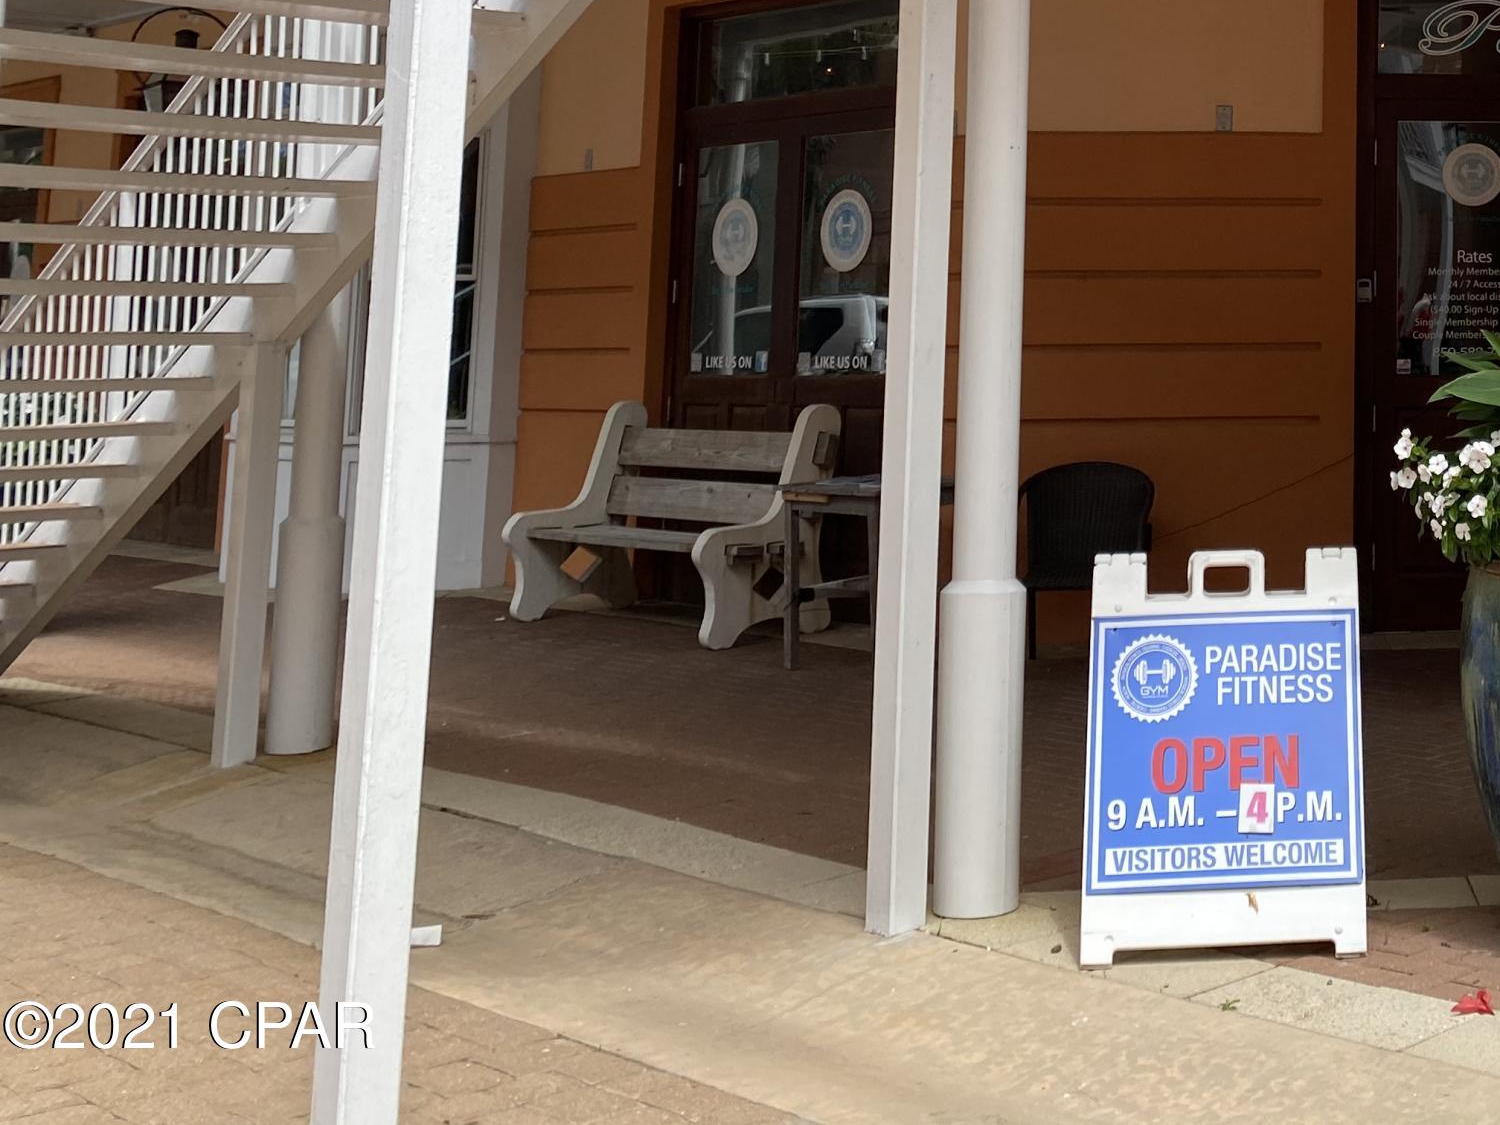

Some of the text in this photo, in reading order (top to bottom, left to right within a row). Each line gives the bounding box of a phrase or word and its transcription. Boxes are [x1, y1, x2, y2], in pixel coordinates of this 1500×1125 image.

[1456, 249, 1493, 264] Rates
[1467, 292, 1489, 301] local
[1445, 318, 1499, 328] Membership
[1446, 330, 1500, 340] Memberp
[705, 356, 724, 369] LIKE
[725, 356, 737, 369] US
[738, 356, 753, 369] ON
[814, 355, 868, 369] LIKE US ON
[1205, 643, 1341, 674] PARADISE
[1141, 685, 1169, 696] GYM
[1217, 674, 1334, 706] FITNESS
[1152, 734, 1299, 794] OPEN
[1107, 799, 1127, 831] 9
[1136, 796, 1204, 828] A.M.
[1277, 790, 1342, 823] P.M.
[1112, 841, 1338, 873] VISITORS WELCOME
